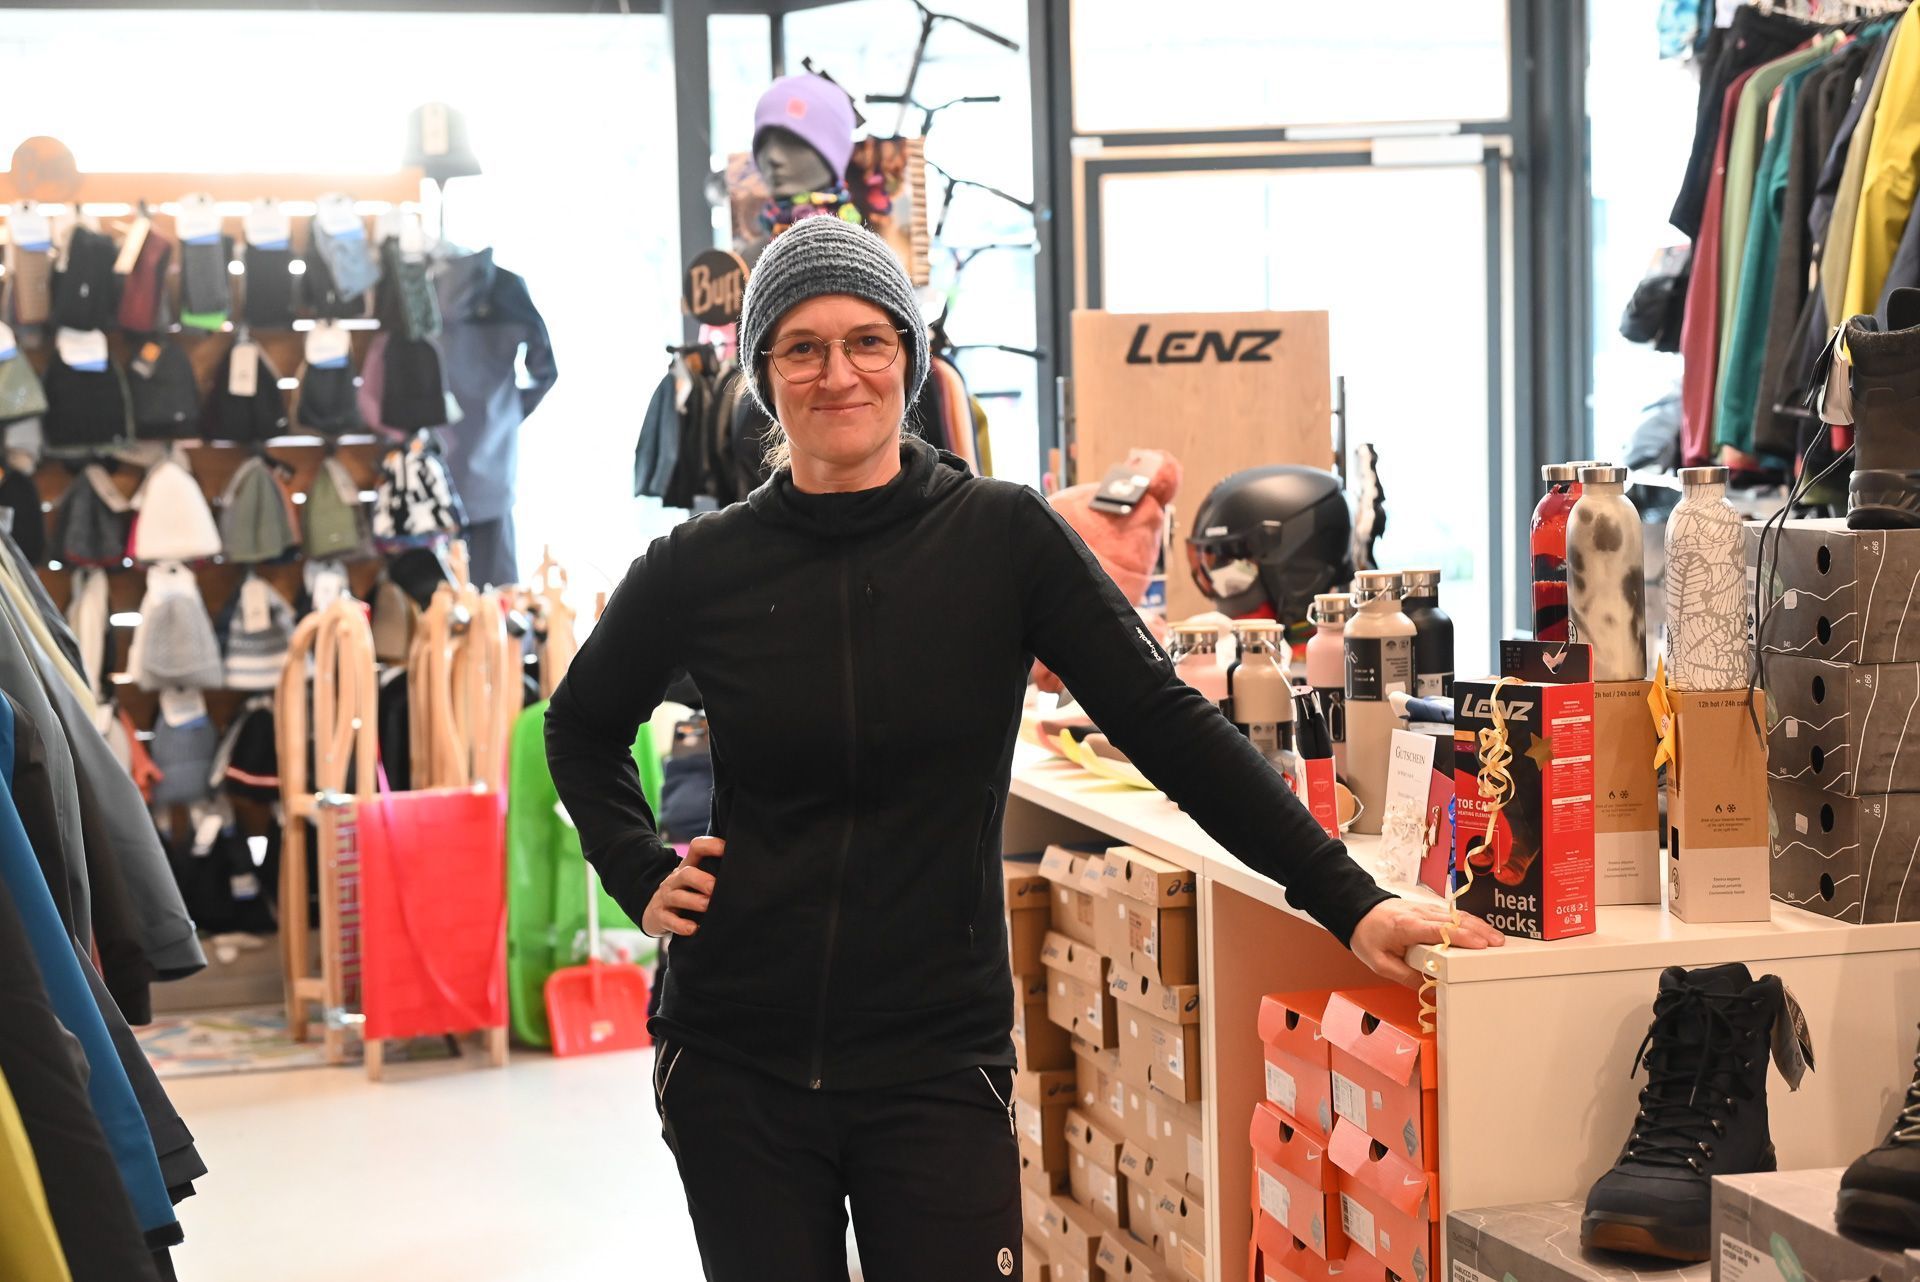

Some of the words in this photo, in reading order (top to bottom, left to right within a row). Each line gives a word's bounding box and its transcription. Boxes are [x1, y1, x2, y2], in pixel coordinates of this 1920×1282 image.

[1126, 323, 1282, 364] LENZ
[1457, 798, 1474, 810] TOE
[1494, 888, 1537, 912] heat
[1486, 912, 1537, 932] socks
